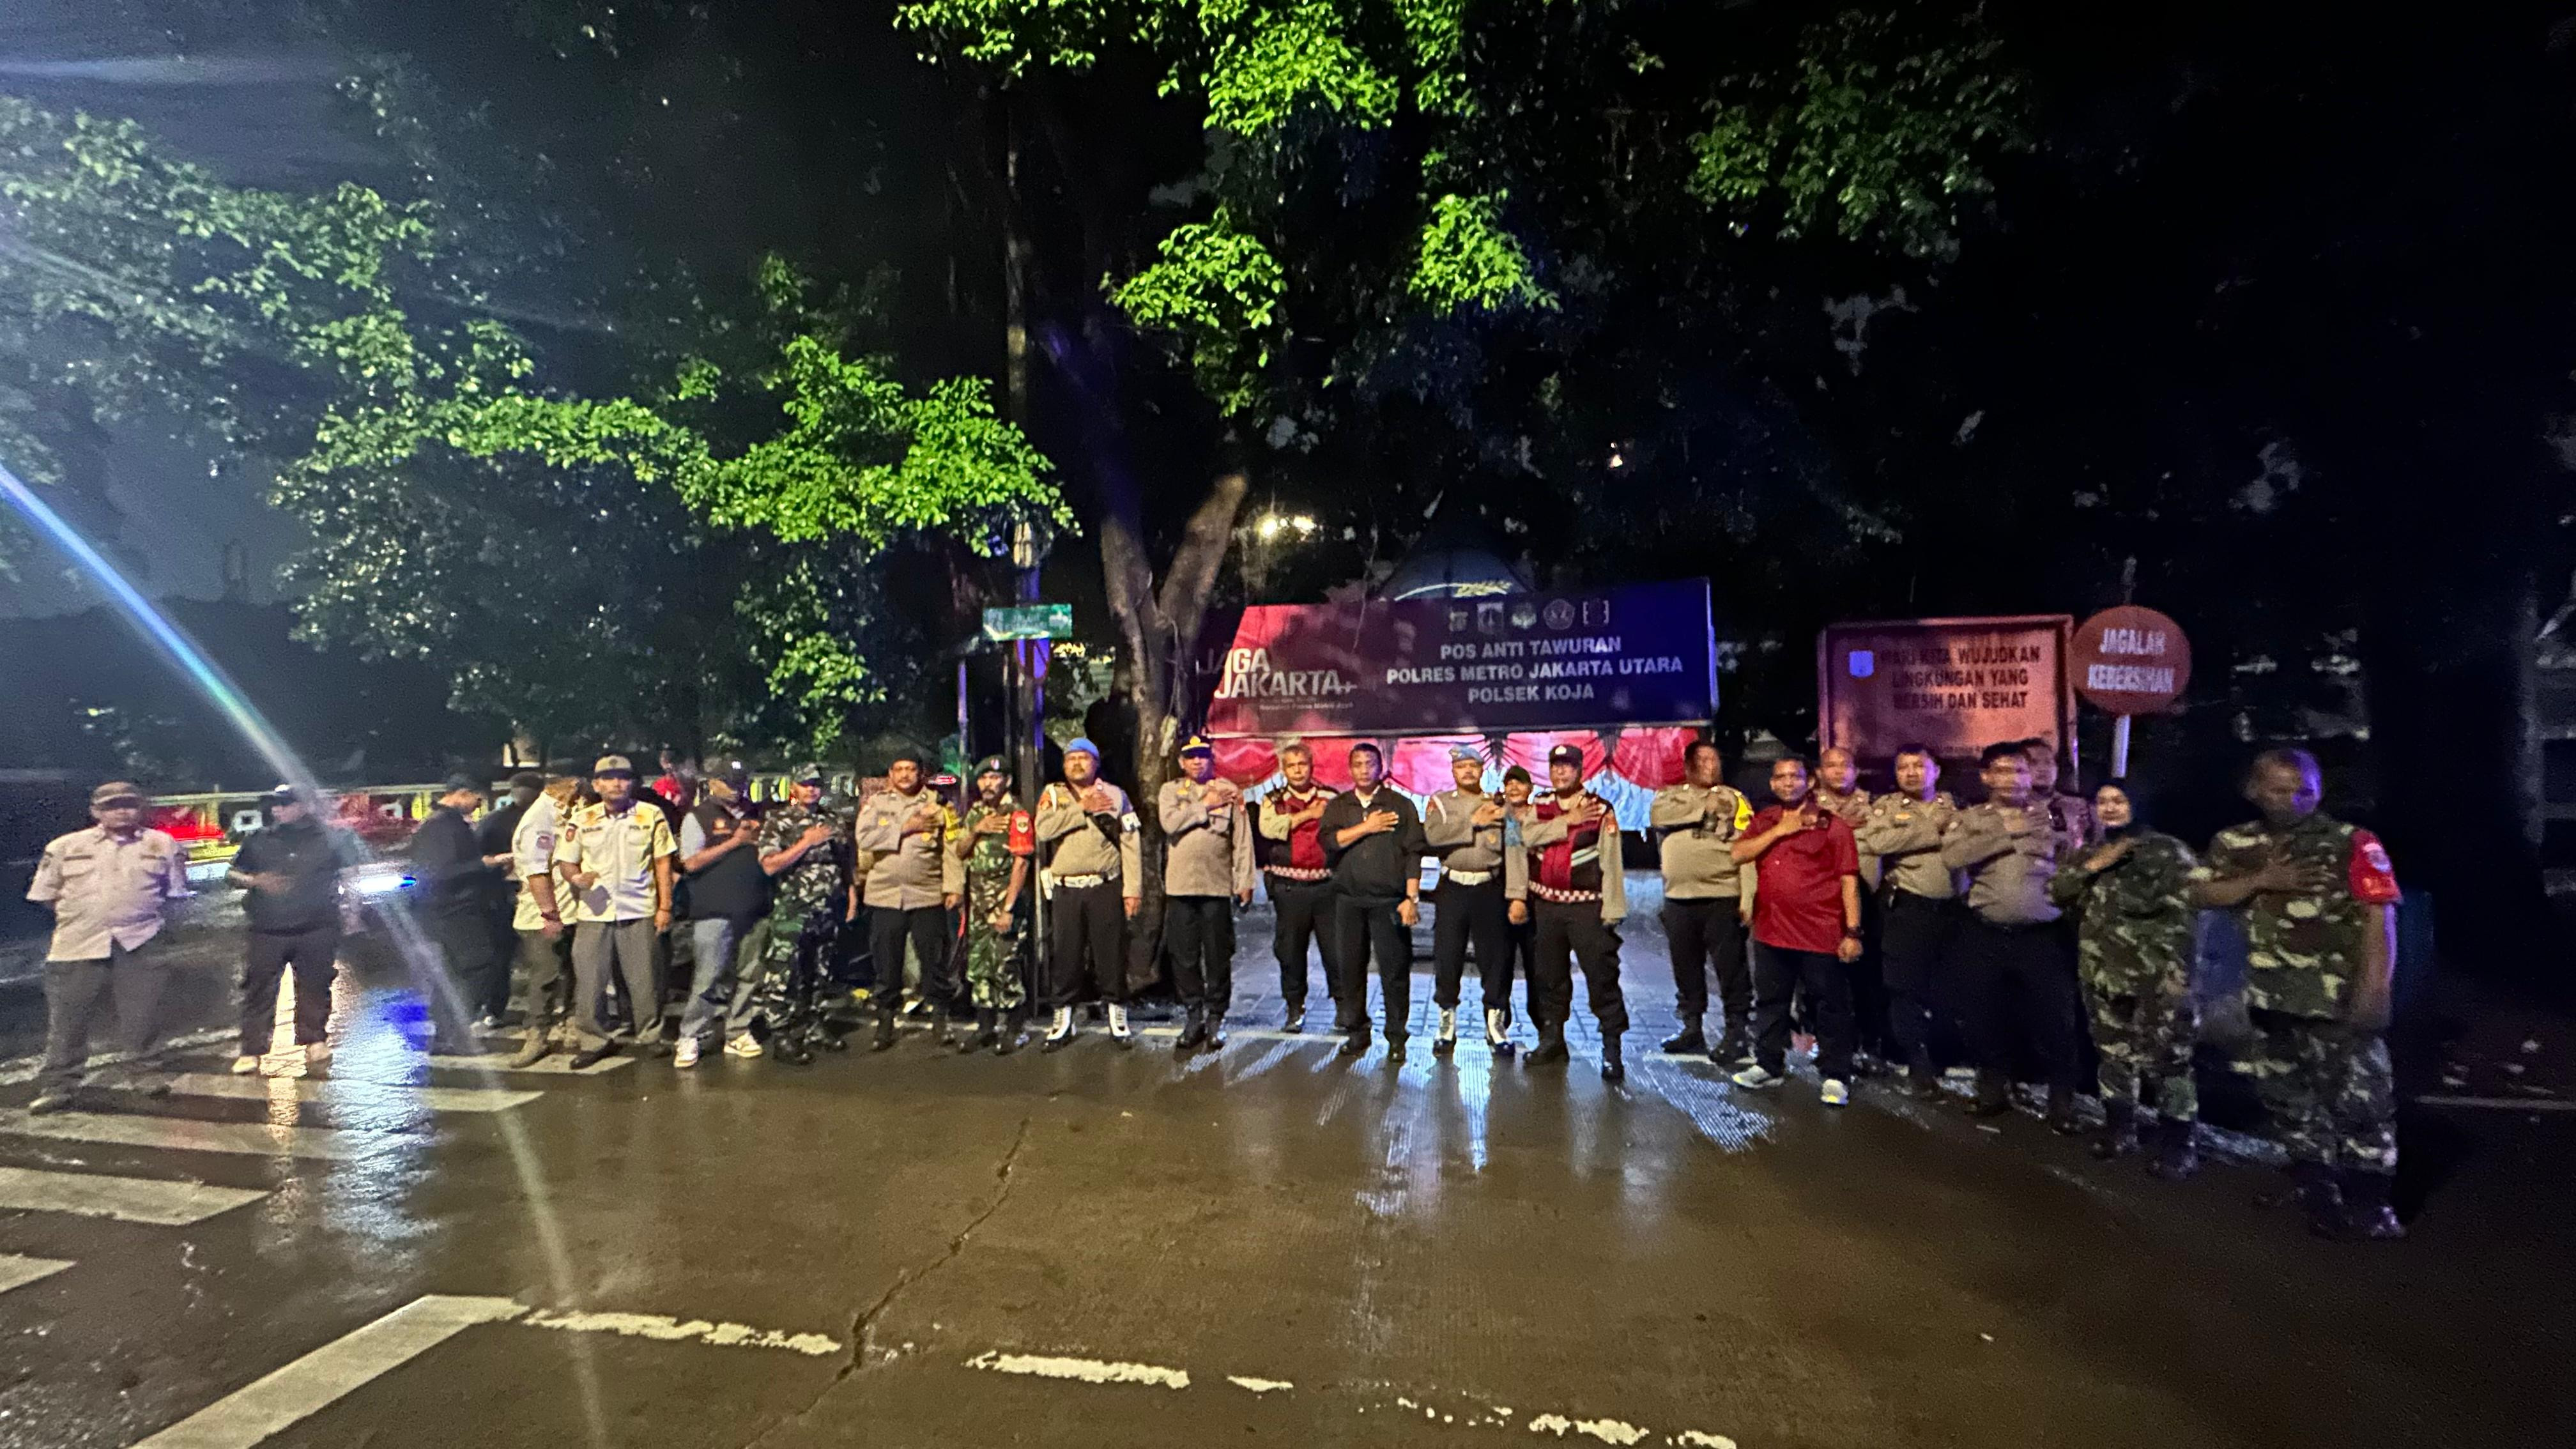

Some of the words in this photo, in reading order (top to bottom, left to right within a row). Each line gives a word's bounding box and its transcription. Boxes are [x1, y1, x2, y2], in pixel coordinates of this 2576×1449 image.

[1441, 643, 1476, 659] POS
[1482, 641, 1524, 658] ANTI
[1529, 636, 1621, 655] TAWURAN
[1958, 645, 2041, 664] WUJUDKAN
[1386, 666, 1455, 684] POLRES
[1460, 663, 1523, 682] METRO
[1529, 659, 1614, 678] JAKARTA
[1619, 656, 1683, 675] UTARA
[1892, 670, 1984, 687] LINGKUNGAN
[1990, 669, 2028, 686] YANG
[1468, 685, 1540, 703] POLSEK
[1545, 683, 1595, 701] KOJA
[1948, 692, 1977, 709] DAN
[1982, 691, 2028, 709] SEHAT
